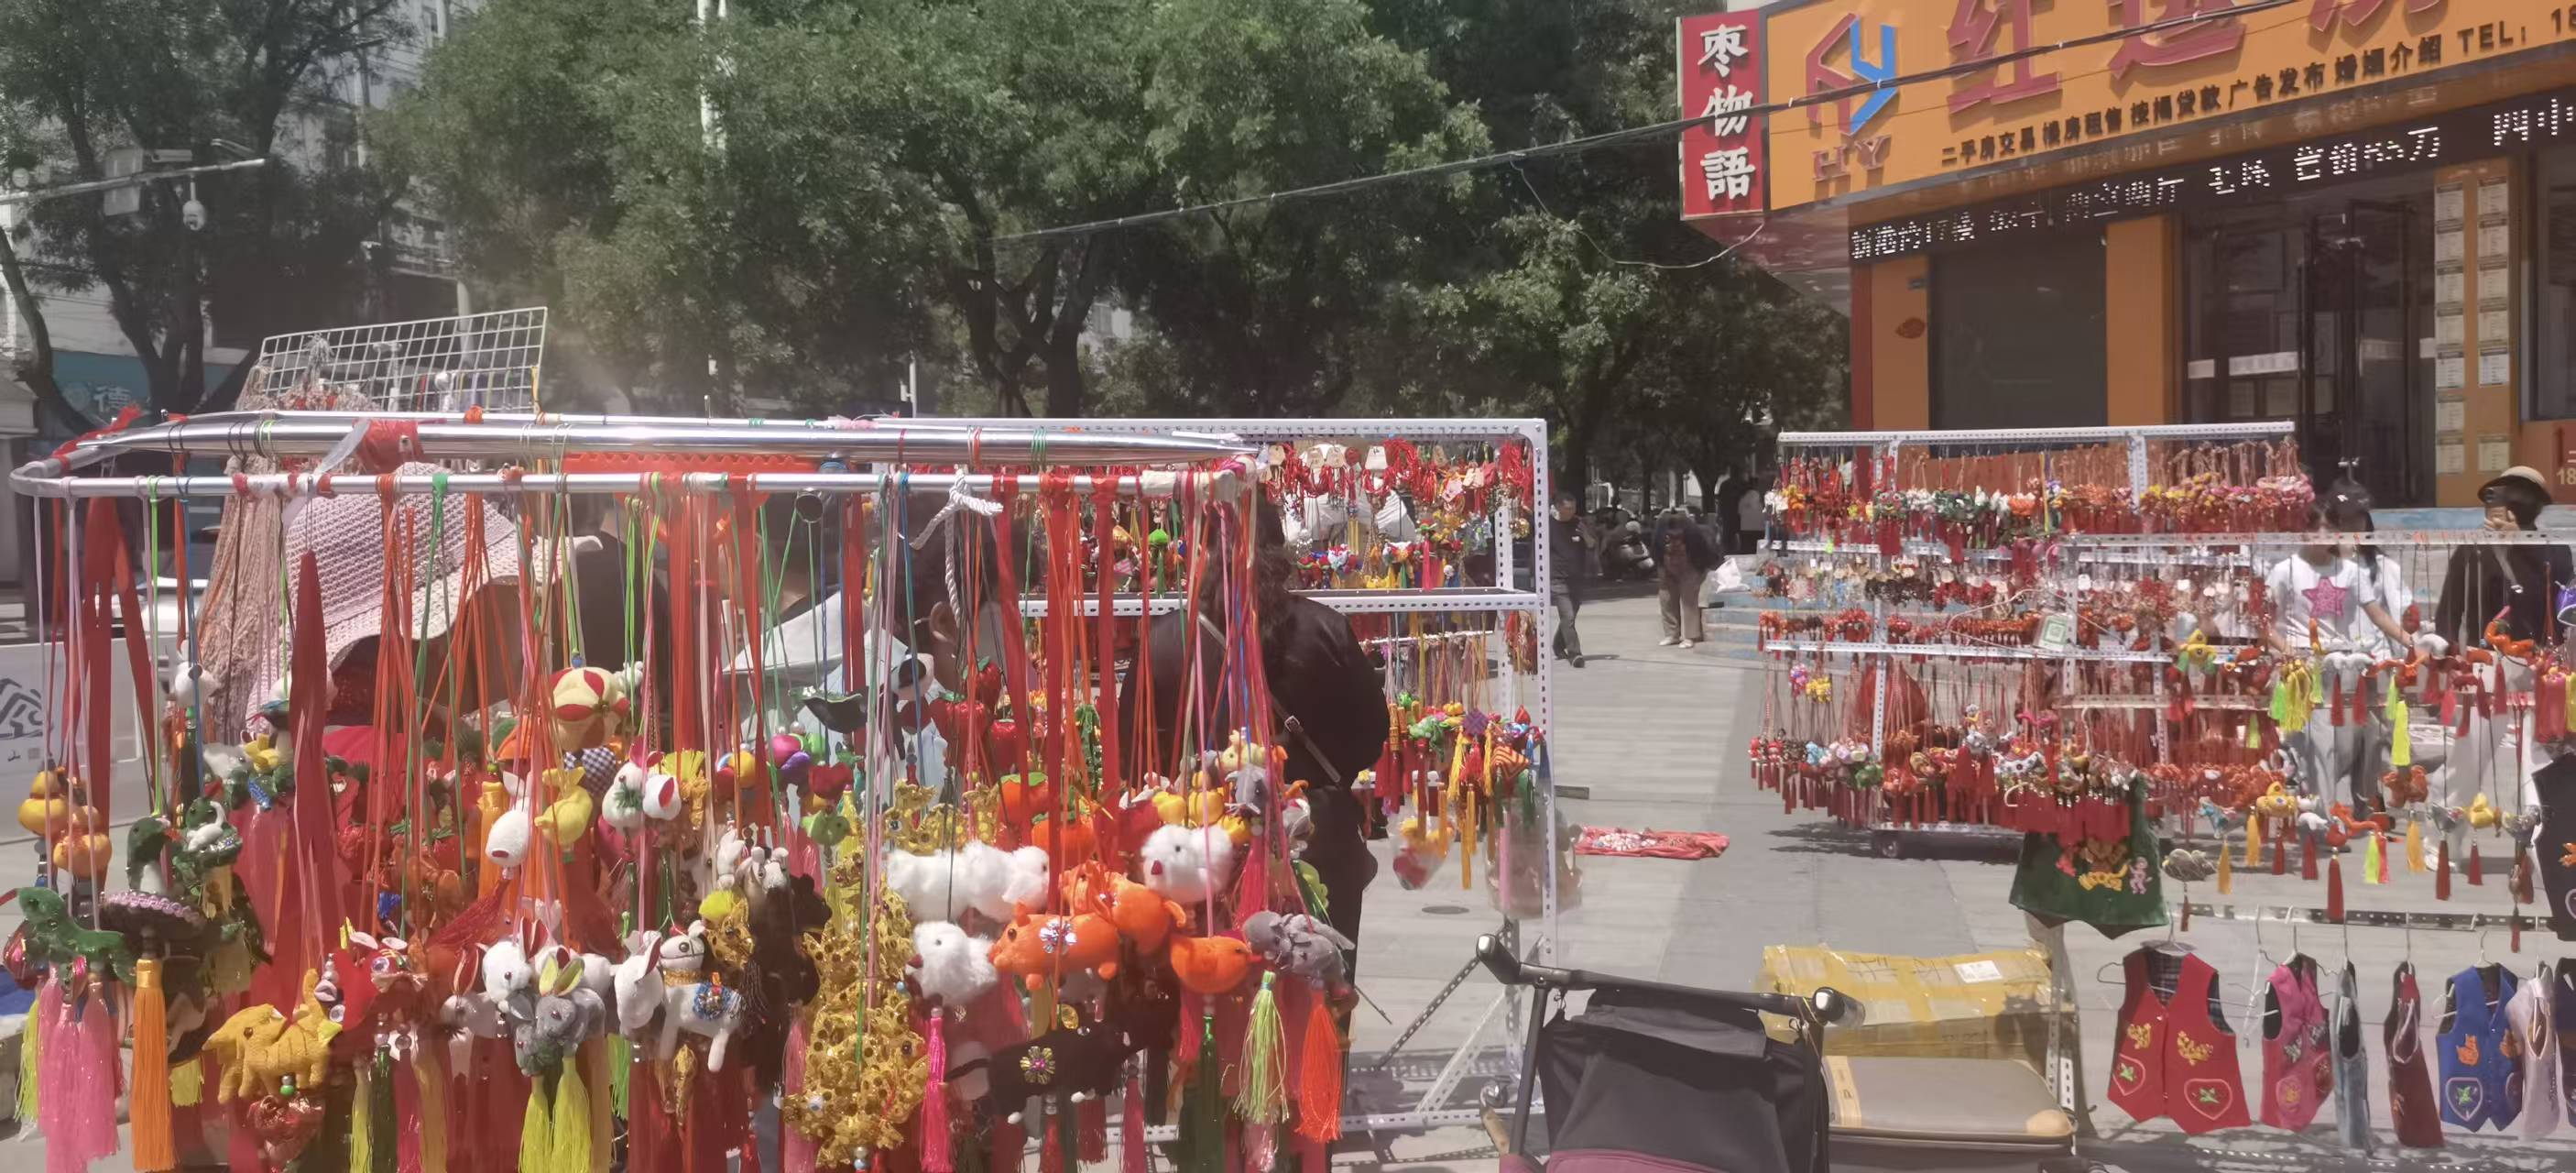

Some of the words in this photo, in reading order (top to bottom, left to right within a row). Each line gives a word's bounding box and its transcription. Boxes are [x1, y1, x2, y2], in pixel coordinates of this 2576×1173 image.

[1697, 24, 1755, 201] 枣物語
[1812, 135, 1891, 182] HY
